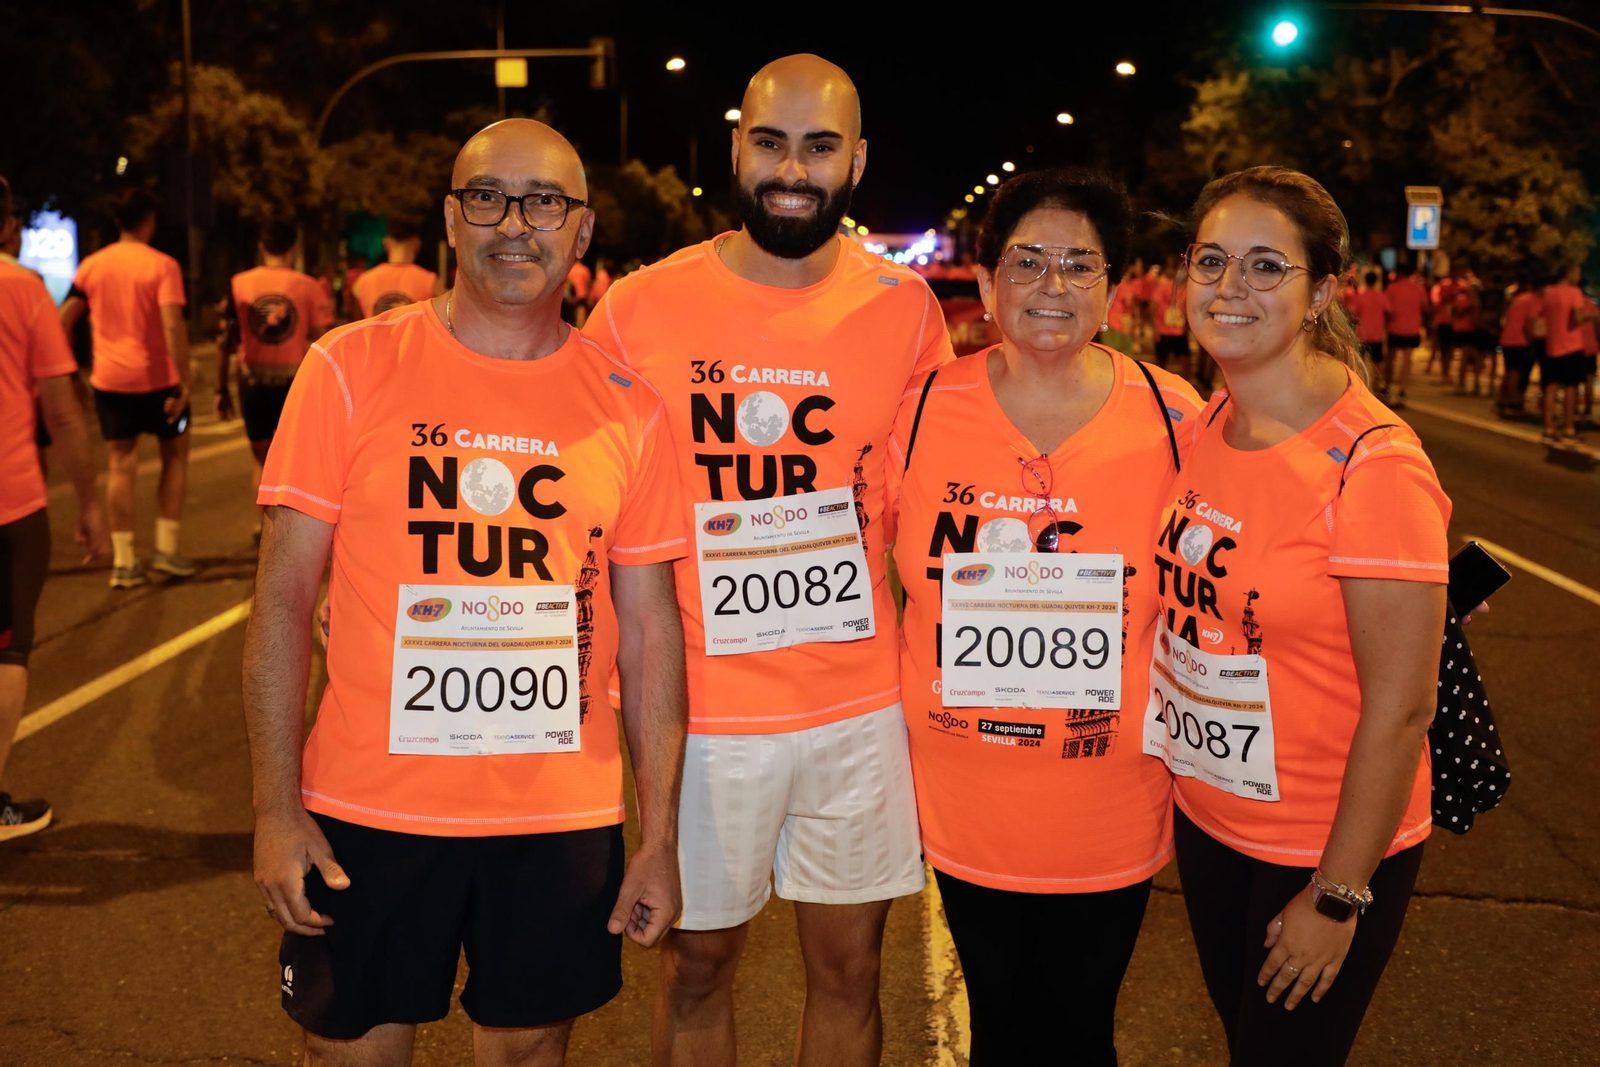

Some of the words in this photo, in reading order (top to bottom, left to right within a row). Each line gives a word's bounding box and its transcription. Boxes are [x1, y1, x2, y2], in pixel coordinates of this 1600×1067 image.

[691, 360, 725, 384] 36
[730, 364, 830, 387] CARRERA
[411, 423, 448, 447] 36
[454, 429, 559, 457] CARRERA
[695, 453, 817, 501] TUR
[943, 482, 976, 505] 36
[979, 491, 1078, 513] CARRERA
[1178, 490, 1200, 509] 36
[408, 521, 554, 581] TUR
[748, 548, 777, 556] NOCTURNA
[791, 540, 831, 551] GUADALQUIVIR
[712, 560, 861, 615] 20082
[1155, 553, 1224, 621] TUR
[842, 617, 869, 628] POWER
[855, 624, 870, 632] ADE
[501, 640, 544, 648] GUADALQUIVIR
[713, 637, 747, 645] Cruzcampo
[954, 626, 1110, 669] 20089
[404, 665, 568, 712] 20090
[949, 689, 986, 697] Cruzcampo
[1085, 689, 1114, 697] POWER
[981, 722, 992, 730] 27
[994, 724, 1042, 735] septiembre
[1154, 688, 1260, 762] 20087
[398, 735, 439, 744] Cruzcampo
[545, 730, 573, 739] POWER
[558, 737, 573, 745] ADE
[981, 734, 1016, 746] SEVILLA
[1018, 738, 1041, 748] 2024
[1243, 780, 1271, 790] POWER
[1256, 787, 1272, 795] ADE
